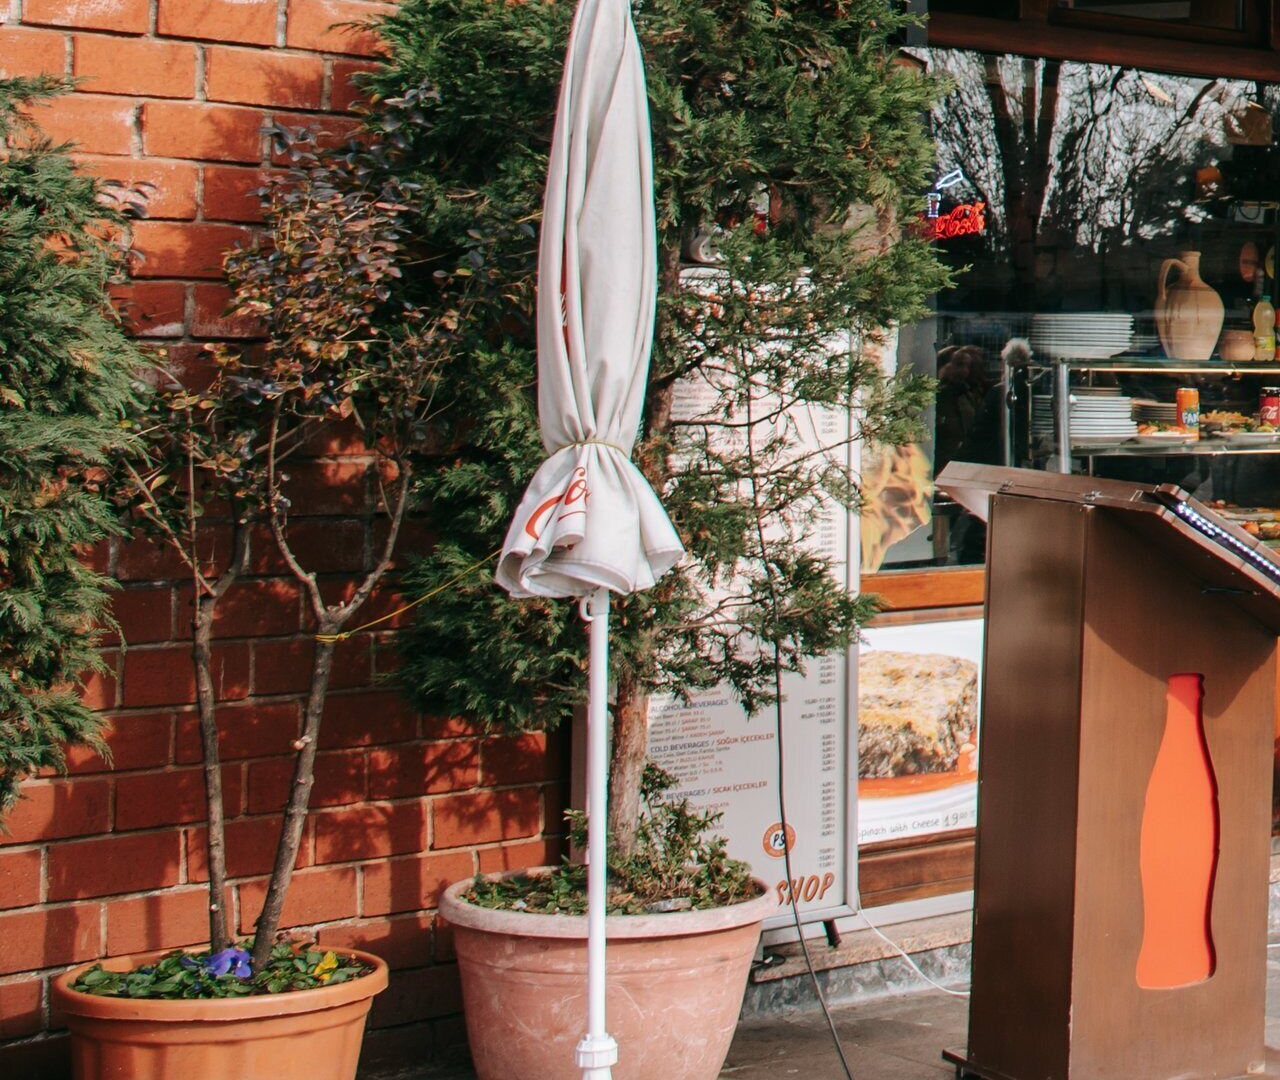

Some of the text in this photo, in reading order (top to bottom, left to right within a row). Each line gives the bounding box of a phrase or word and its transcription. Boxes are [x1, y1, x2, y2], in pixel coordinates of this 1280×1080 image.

[650, 745, 669, 753] COLD
[670, 740, 709, 751] BEVERAGES
[890, 821, 909, 832] with
[912, 819, 941, 830] Cheese
